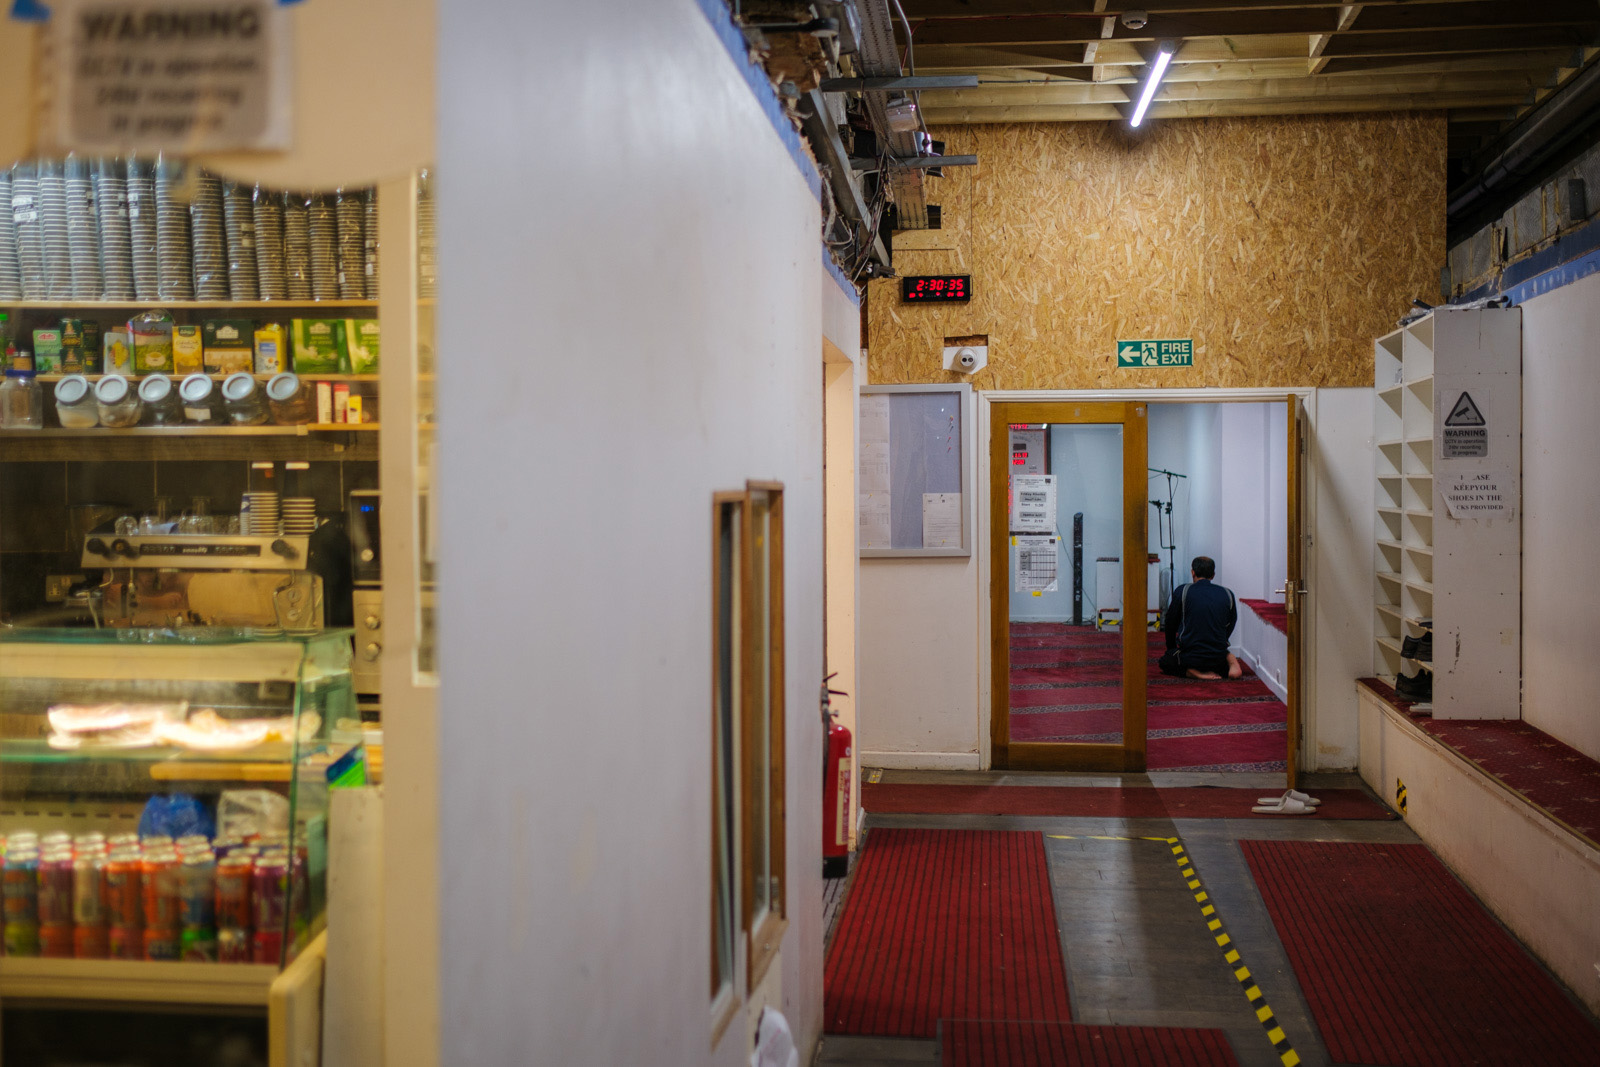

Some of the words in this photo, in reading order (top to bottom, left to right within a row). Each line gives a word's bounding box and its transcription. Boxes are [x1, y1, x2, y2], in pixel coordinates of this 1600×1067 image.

[82, 8, 260, 41] WARNING
[916, 278, 964, 291] 2:30:35
[1161, 342, 1190, 353] FIRE
[1161, 353, 1190, 365] EXIT
[1445, 429, 1486, 437] WARNING
